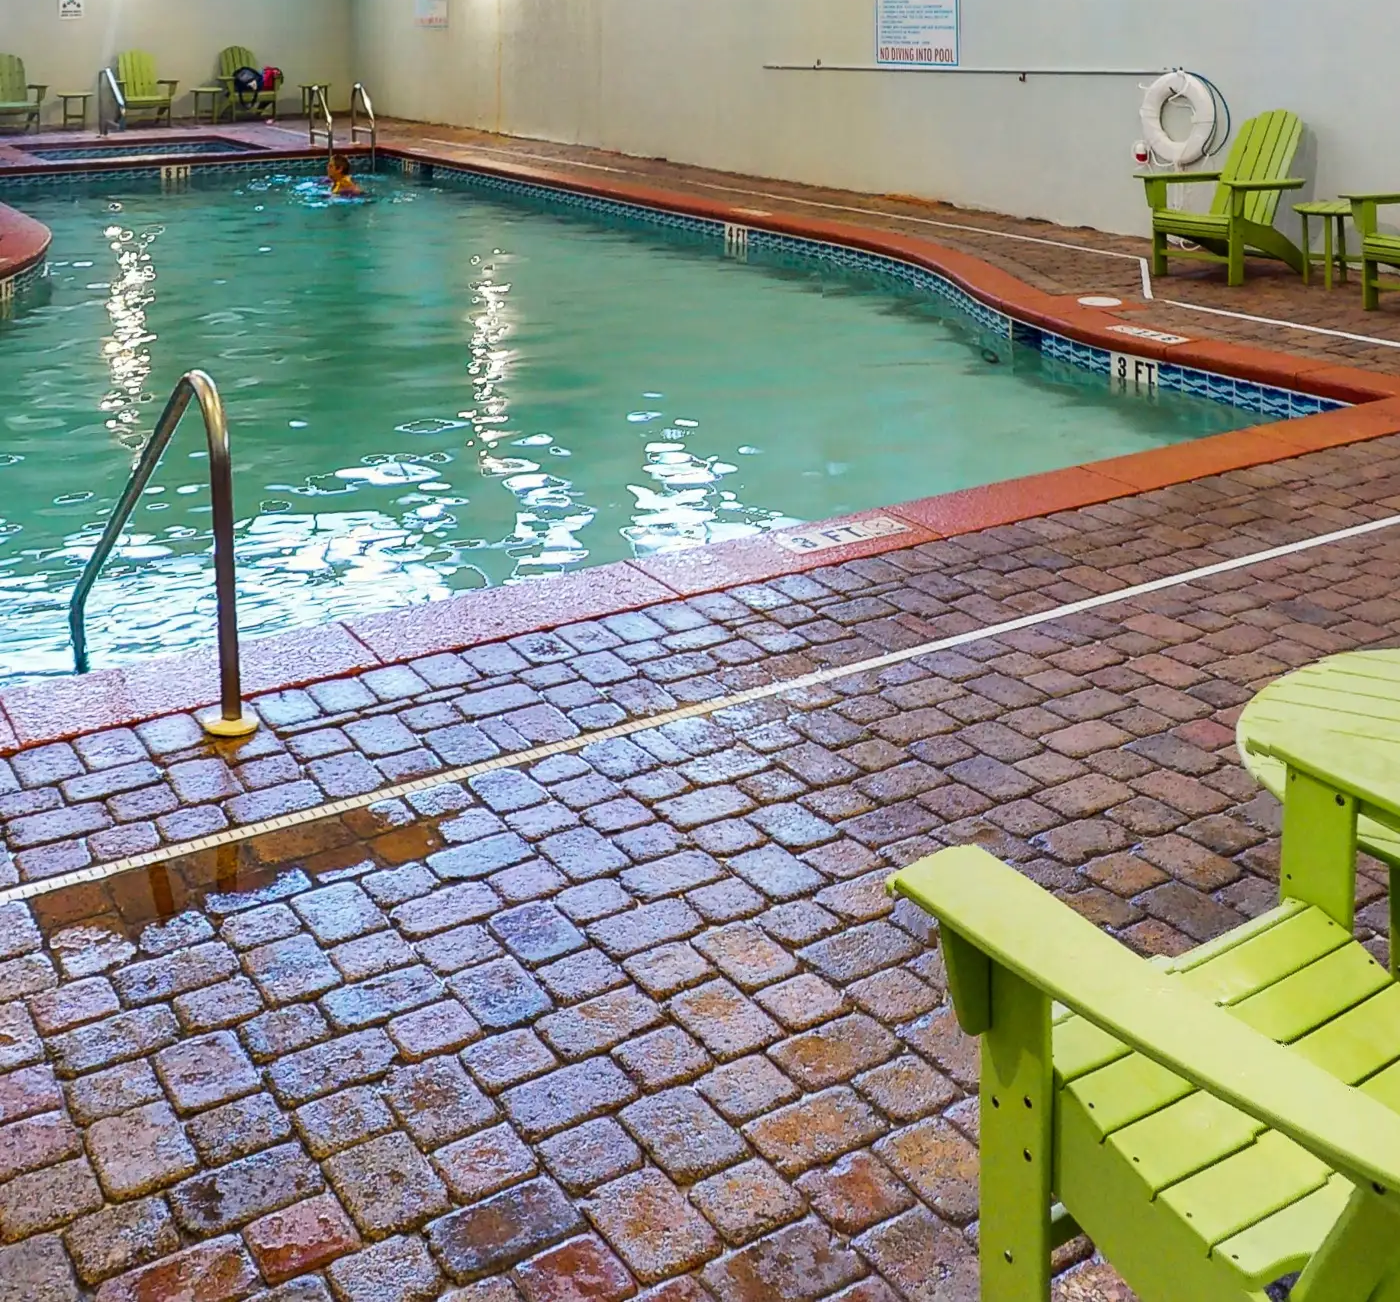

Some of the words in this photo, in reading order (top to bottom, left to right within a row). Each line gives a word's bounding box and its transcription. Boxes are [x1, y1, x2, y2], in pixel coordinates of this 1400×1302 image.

[880, 47, 890, 60] NO
[891, 47, 914, 61] DIVING
[915, 47, 932, 62] INTO
[934, 48, 954, 63] POOL
[176, 166, 188, 179] FT
[728, 226, 733, 240] 4
[1117, 356, 1127, 379] 3
[791, 537, 818, 549] 3
